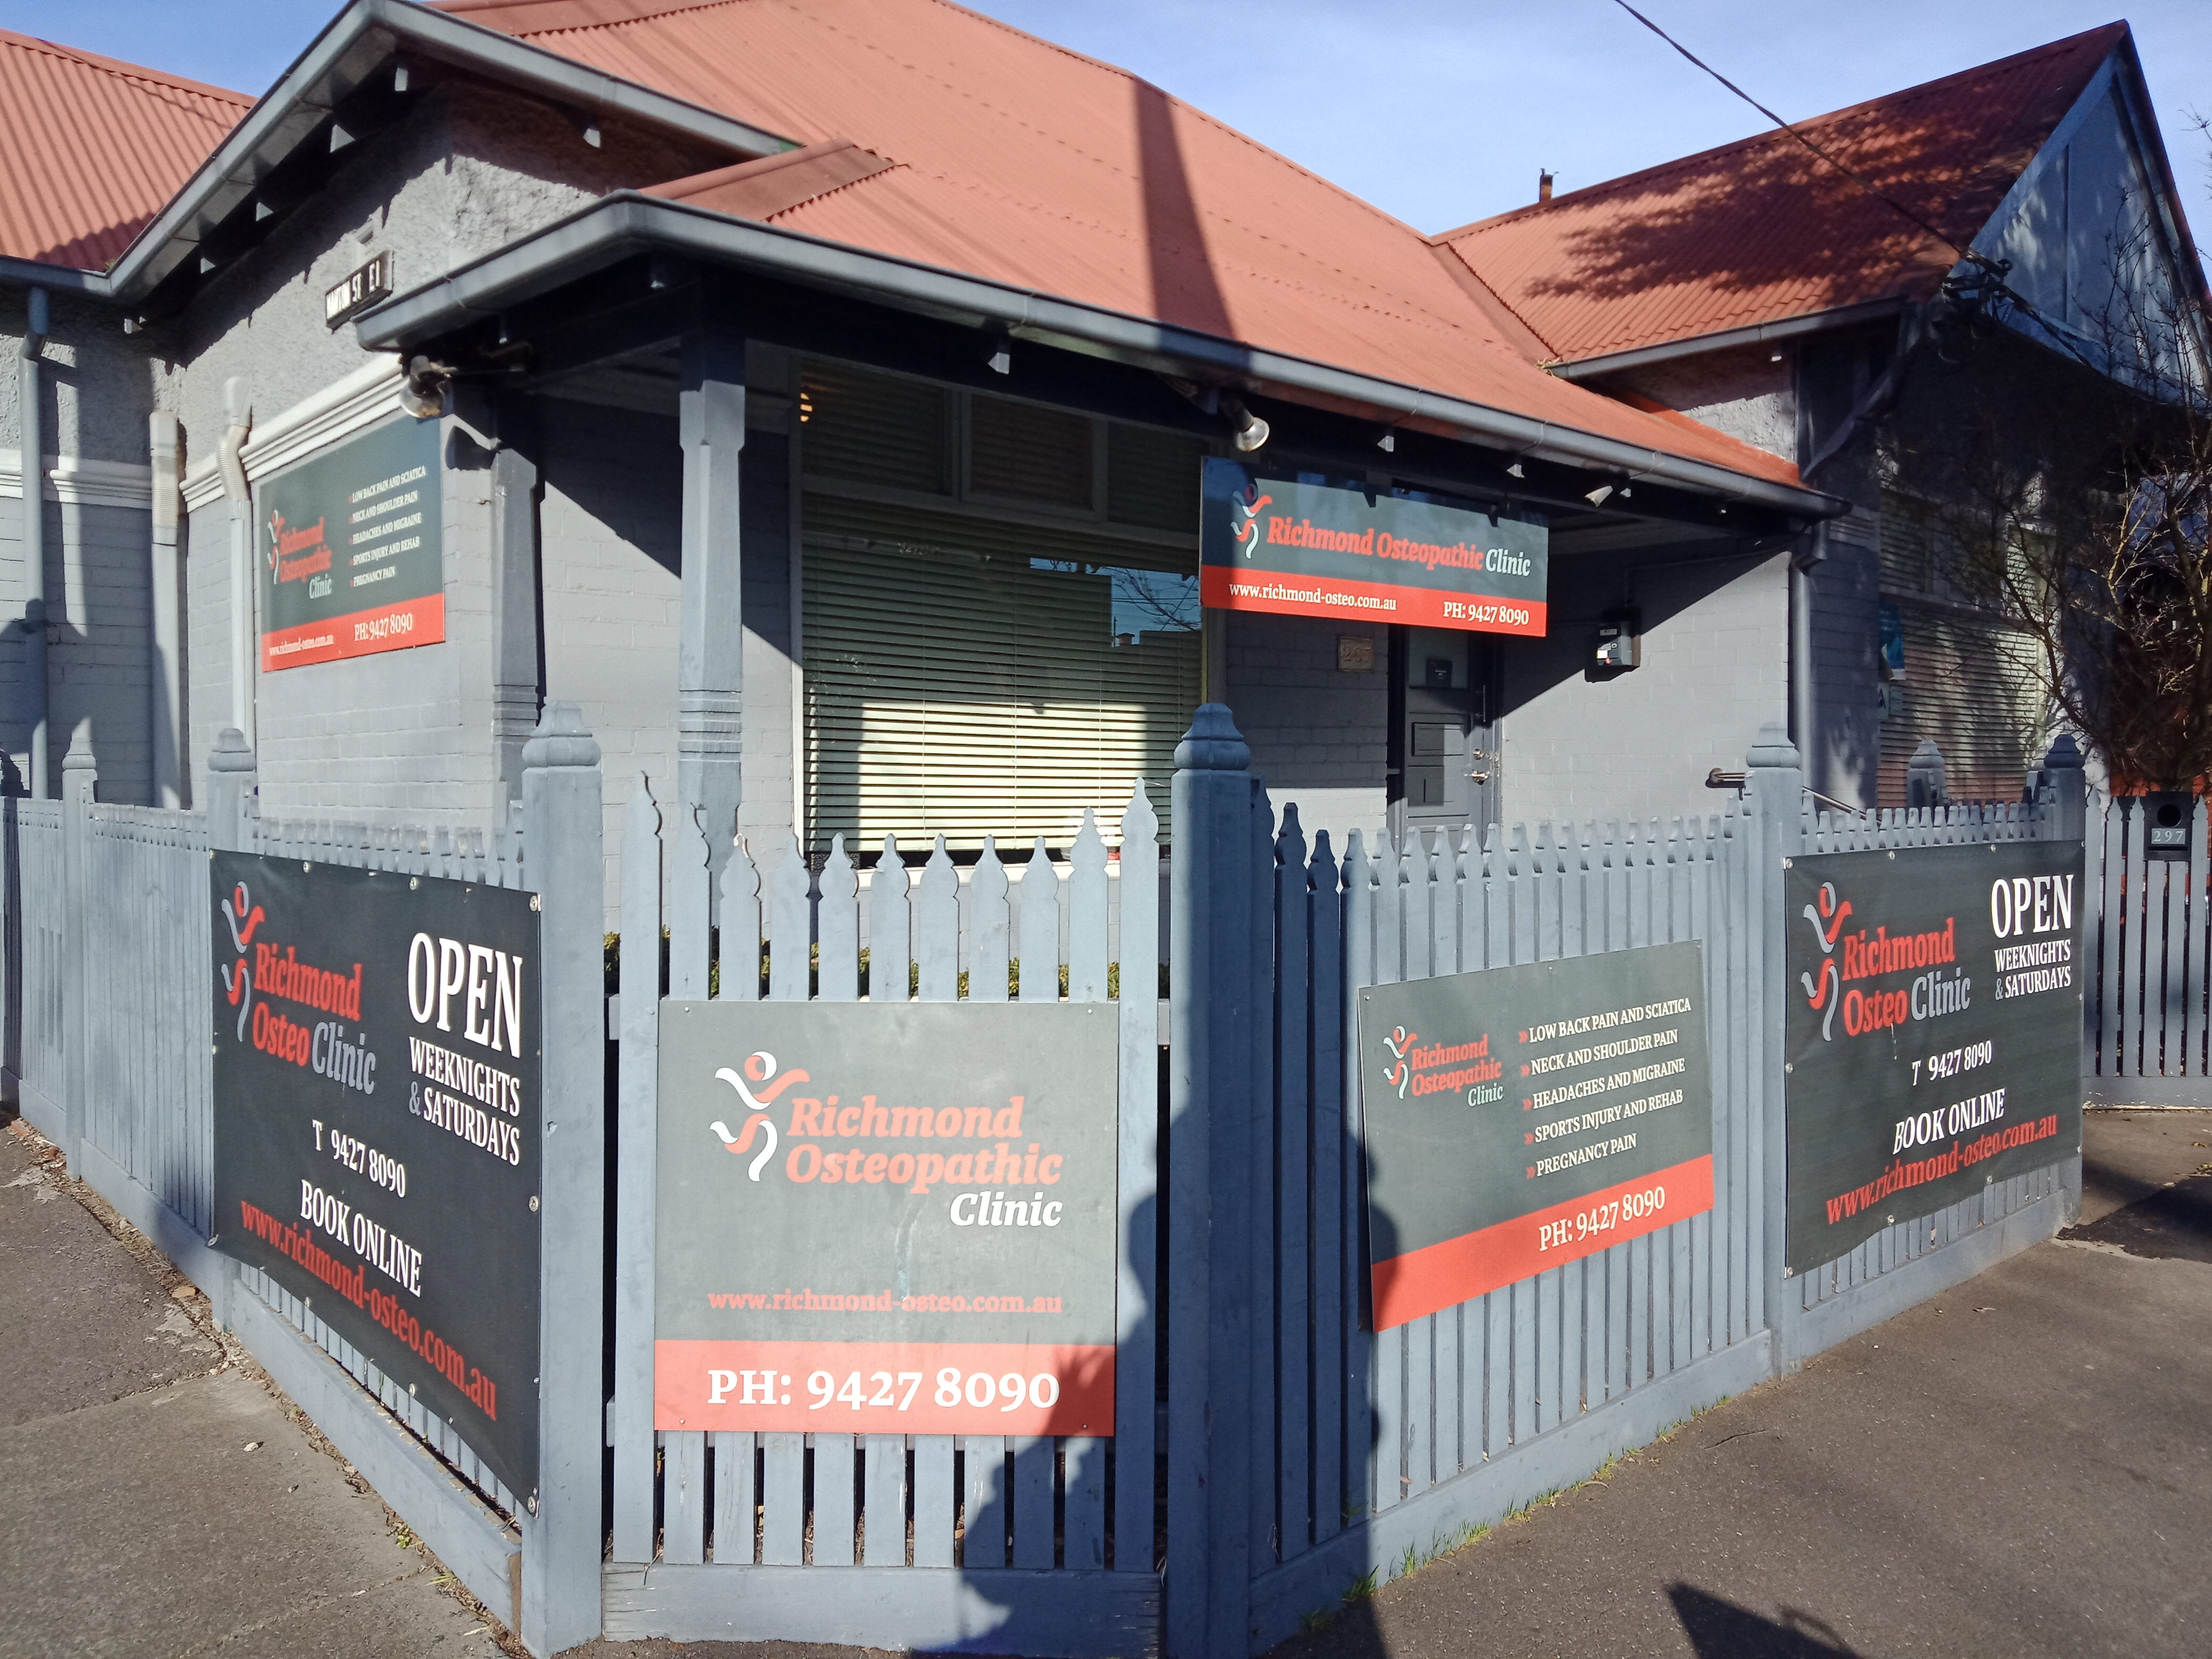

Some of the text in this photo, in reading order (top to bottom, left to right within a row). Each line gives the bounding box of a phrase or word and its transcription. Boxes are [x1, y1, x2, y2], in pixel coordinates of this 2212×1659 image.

[353, 465, 426, 503] LOW BACK PAIN AND SCIATICA
[353, 490, 418, 523] NECK AND SHOULDER PAIN
[353, 512, 422, 544] HEADACHES AND MIGRAINE
[353, 536, 421, 565] SPORTS INJURY AND REHAB
[1267, 516, 1532, 577] Richmond Osteopathic Clinic
[308, 573, 332, 599] Clinic
[353, 566, 396, 586] PREGNANCY PAIN
[1229, 582, 1529, 626] www.richmond-osteo.com.au PH: 9427 8090
[354, 613, 413, 641] PH: 9427 8090
[2154, 831, 2184, 842] 297
[1991, 874, 2074, 939] OPEN
[1841, 916, 1956, 982] Richmond
[1994, 939, 2072, 973] WEEKNIGHTS
[253, 942, 363, 1022] Richmond
[407, 932, 523, 1059] OPEN
[1842, 967, 1971, 1037] Osteo Clinic
[1995, 965, 2072, 1001] & SATURDAYS
[1529, 998, 1692, 1043] LOW BACK PAIN AND SCIATICA
[253, 1001, 376, 1095] Osteo Clinic
[1411, 1034, 1489, 1071] Richmond
[1530, 1028, 1679, 1076] NECK AND SHOULDER PAIN
[1912, 1040, 1992, 1086] T 9427 8090
[408, 1036, 521, 1118] WEEKNIGHTS
[1411, 1058, 1502, 1096] Osteopathic
[1467, 1082, 1504, 1107] Clinic
[1532, 1057, 1686, 1110] HEADACHES AND MIGRAINE
[409, 1080, 520, 1167] & SATURDAYS
[786, 1094, 1025, 1138] Richmond
[1534, 1088, 1683, 1143] SPORTS INJURY AND REHAB
[1892, 1087, 2006, 1155] BOOK ONLINE
[312, 1119, 406, 1199] T 9427 8090
[785, 1142, 1063, 1194] Osteopathic
[1536, 1133, 1637, 1177] PREGNANCY PAIN
[1825, 1114, 2058, 1225] www.richmond-osteo.com.au
[950, 1191, 1063, 1227] Clinic
[1539, 1186, 1666, 1252] PH: 9427 8090
[300, 1178, 422, 1298] BOOK ONLINE
[240, 1200, 497, 1421] www.richmond-osteo.com.au
[707, 1289, 1063, 1313] www.richmond-osteo.com.au
[707, 1367, 1060, 1412] PH: 9427 8090
